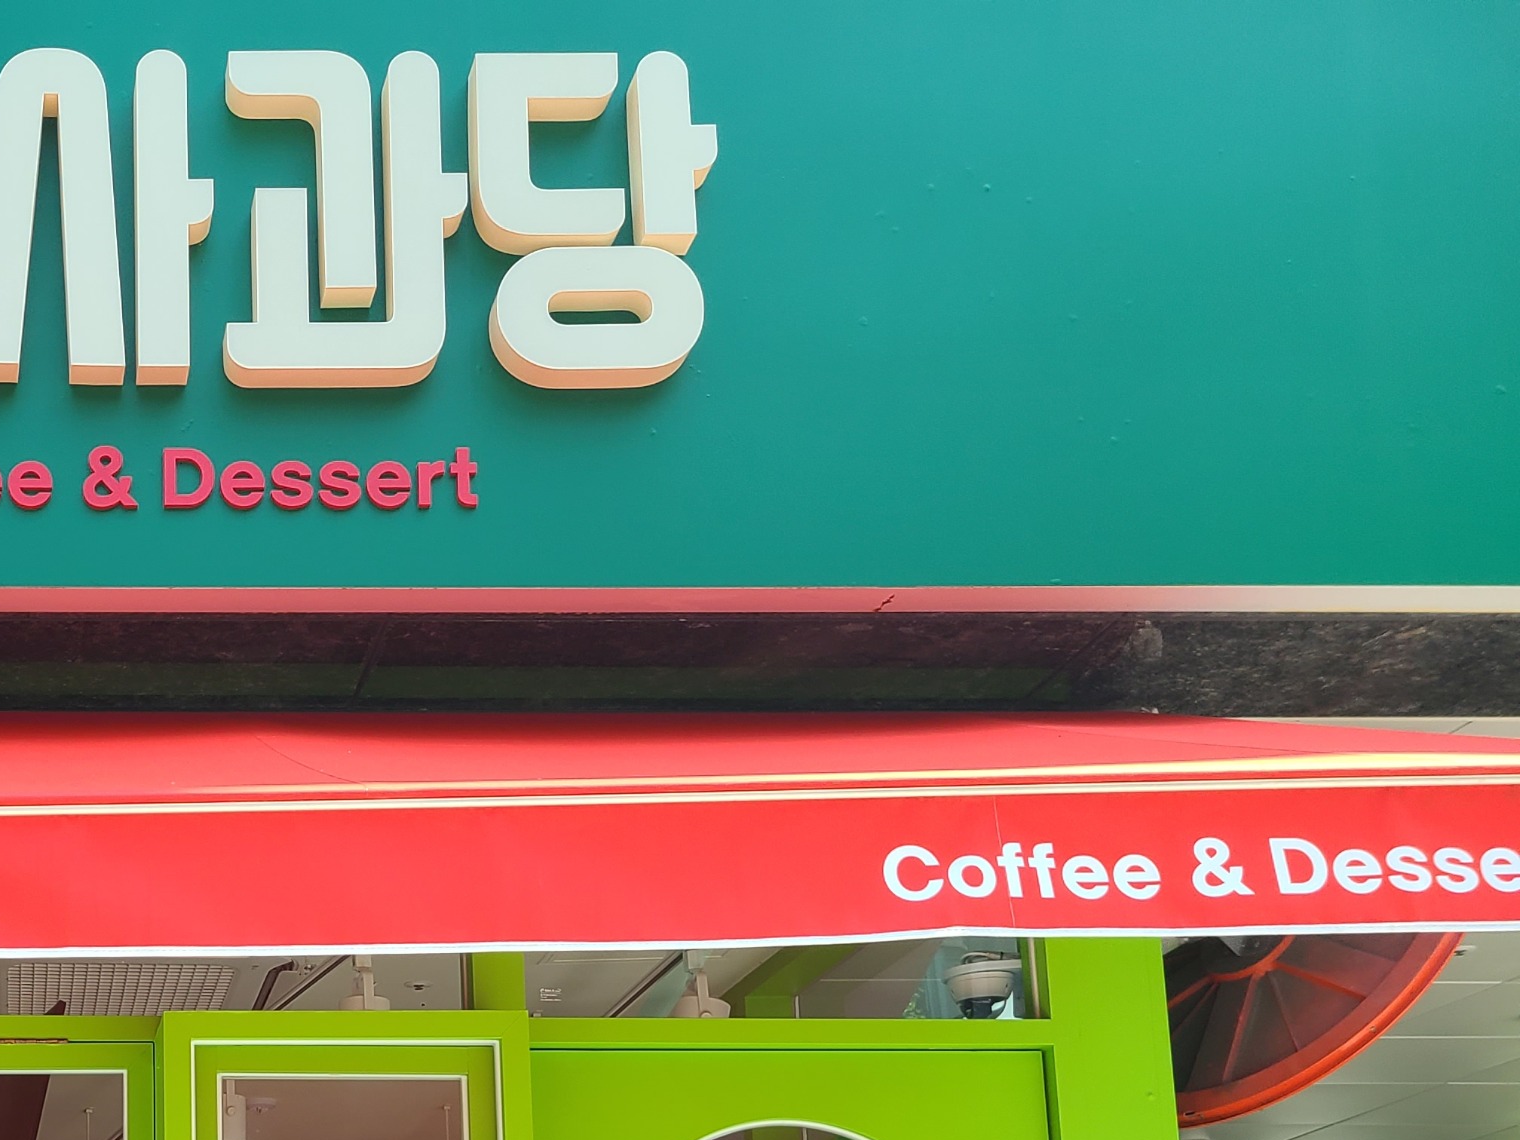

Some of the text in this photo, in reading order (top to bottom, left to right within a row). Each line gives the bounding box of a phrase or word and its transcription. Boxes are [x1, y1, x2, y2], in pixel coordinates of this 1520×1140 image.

[81, 446, 139, 511] &
[162, 446, 481, 511] Dessert
[883, 842, 1162, 901] Coffee
[1191, 837, 1255, 897] &
